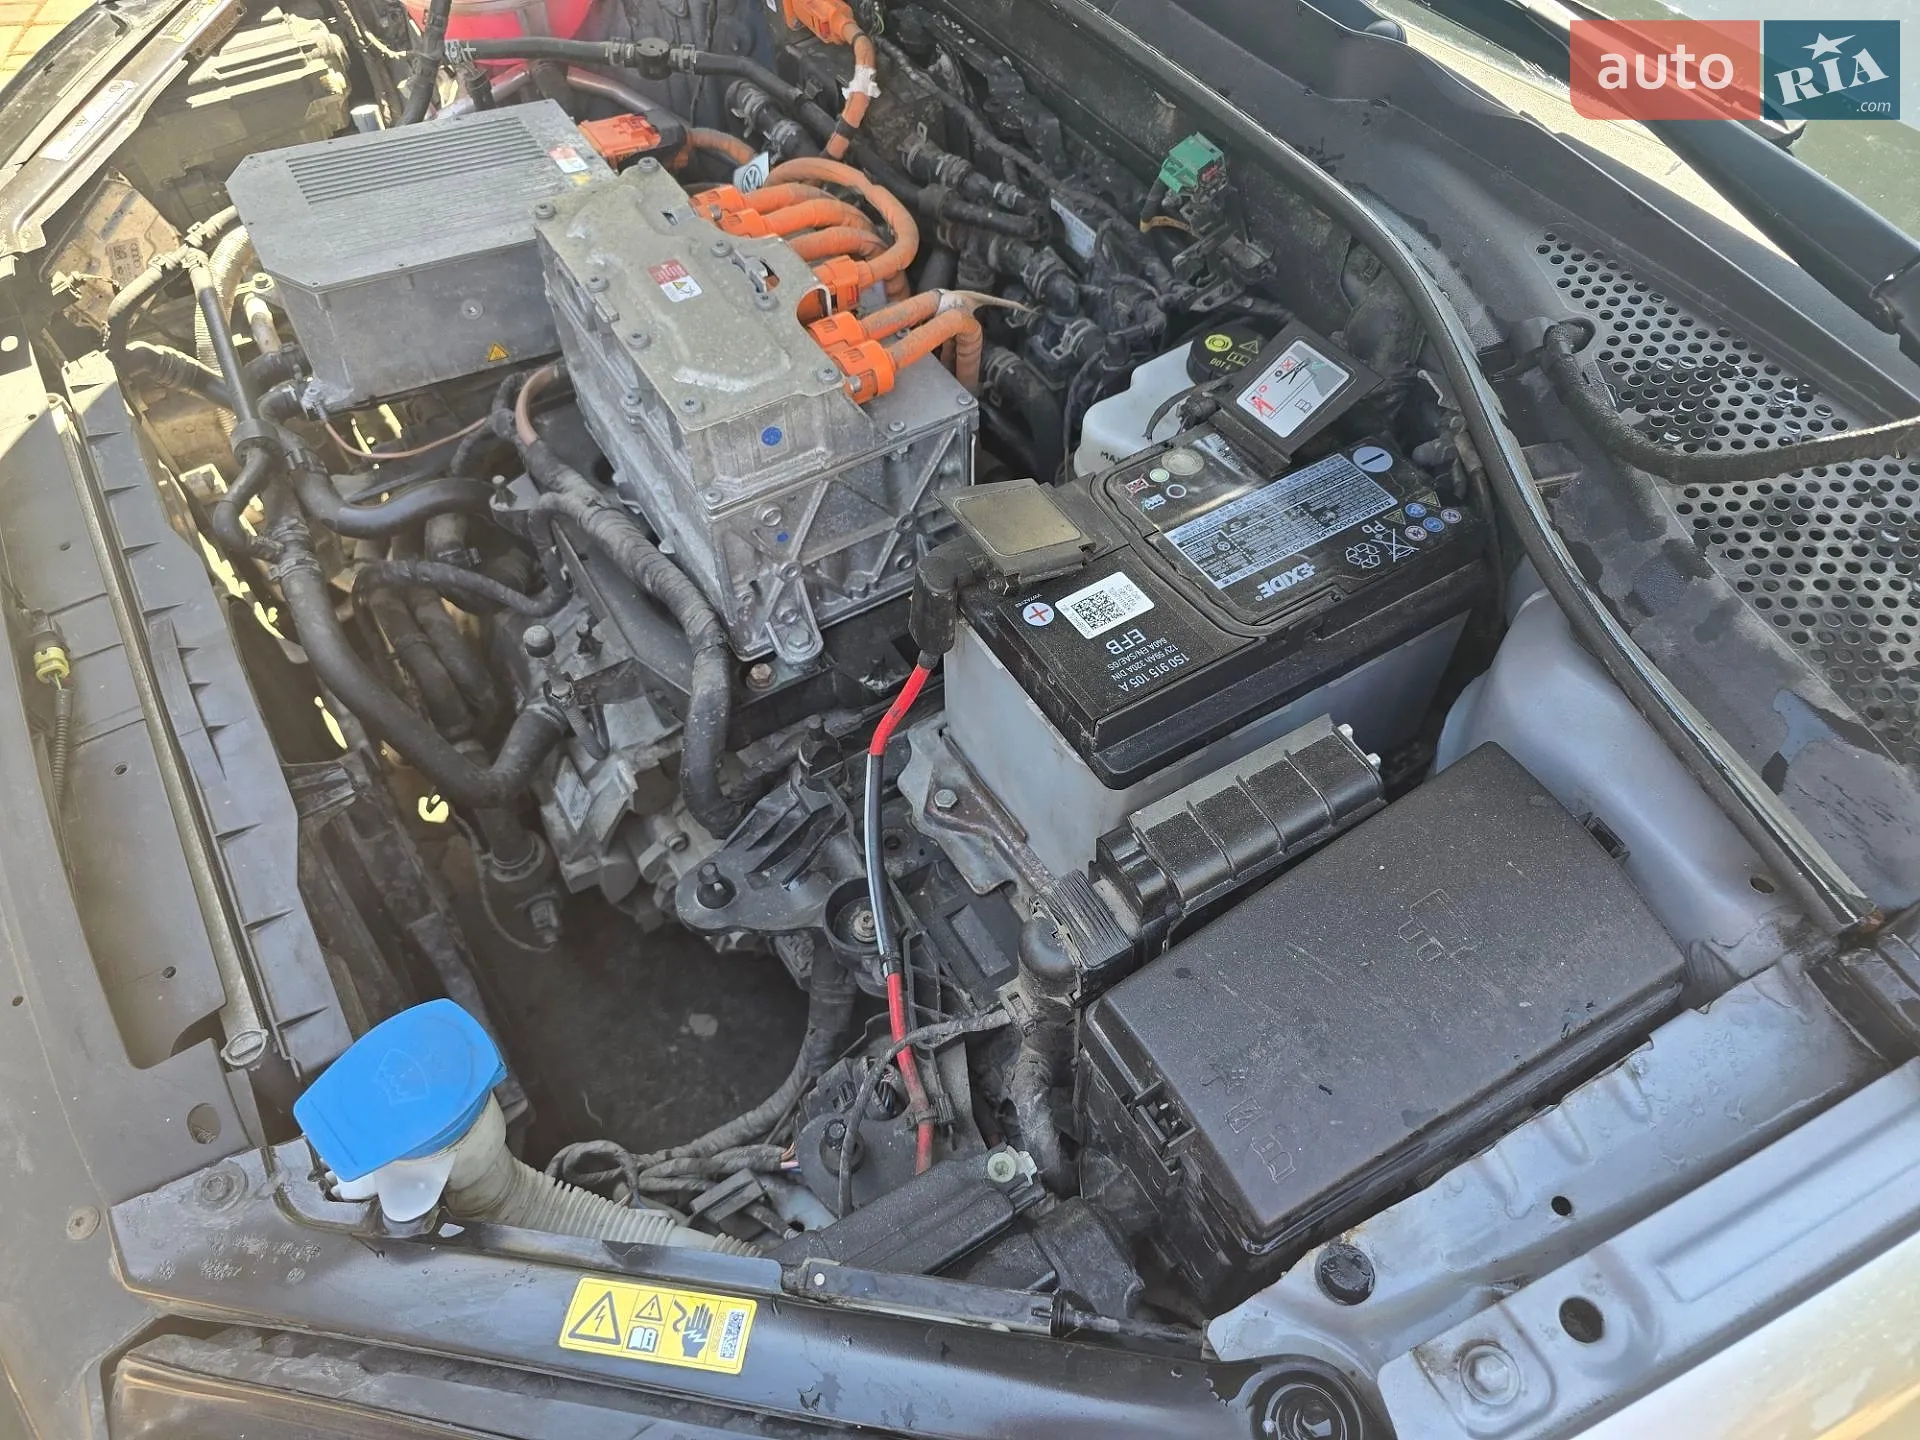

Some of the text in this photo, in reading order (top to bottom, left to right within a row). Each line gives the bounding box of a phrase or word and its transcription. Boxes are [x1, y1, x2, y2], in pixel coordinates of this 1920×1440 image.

[1360, 519, 1386, 534] Pb
[1257, 561, 1317, 599] EXIDE
[1105, 628, 1147, 655] EFB
[1163, 642, 1179, 654] 12V
[1117, 651, 1189, 691] 1S0 915 105 A
[1125, 659, 1145, 673] 320A
[1110, 669, 1127, 680] DIN
